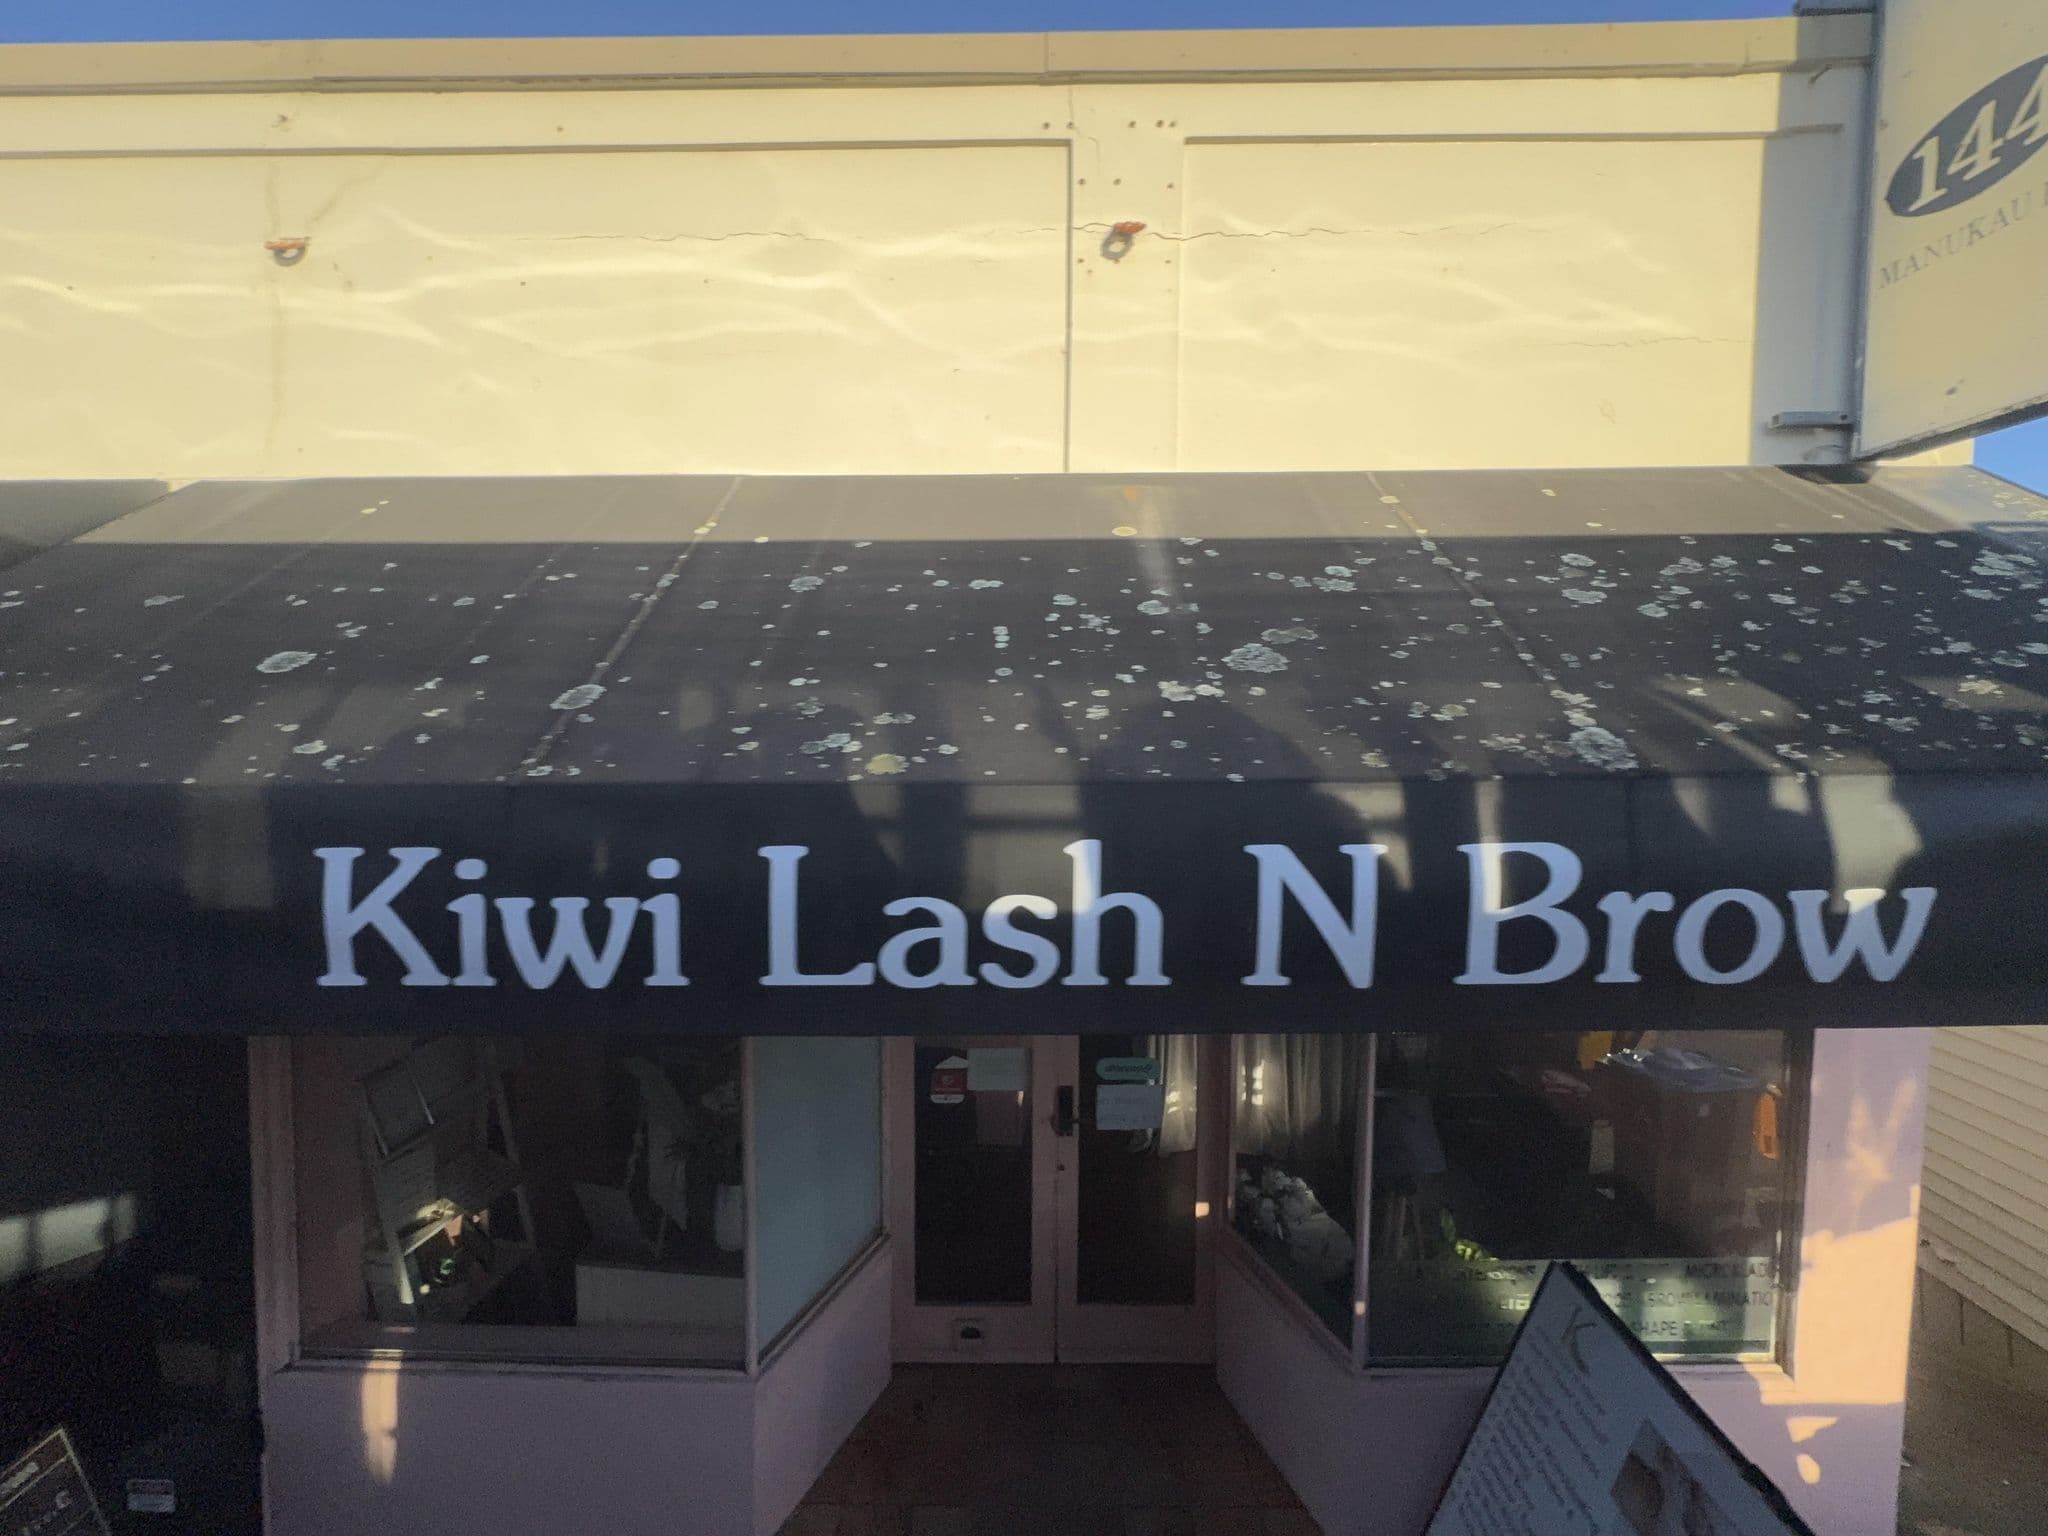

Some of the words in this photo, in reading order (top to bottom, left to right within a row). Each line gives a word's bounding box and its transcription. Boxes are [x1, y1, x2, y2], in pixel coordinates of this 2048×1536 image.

[1908, 64, 2048, 211] 144
[1879, 191, 2032, 289] MANUKAU
[313, 846, 690, 990] Kiwi
[758, 839, 1172, 989] Lash
[1243, 843, 1389, 989] N
[1452, 841, 1938, 986] Brow
